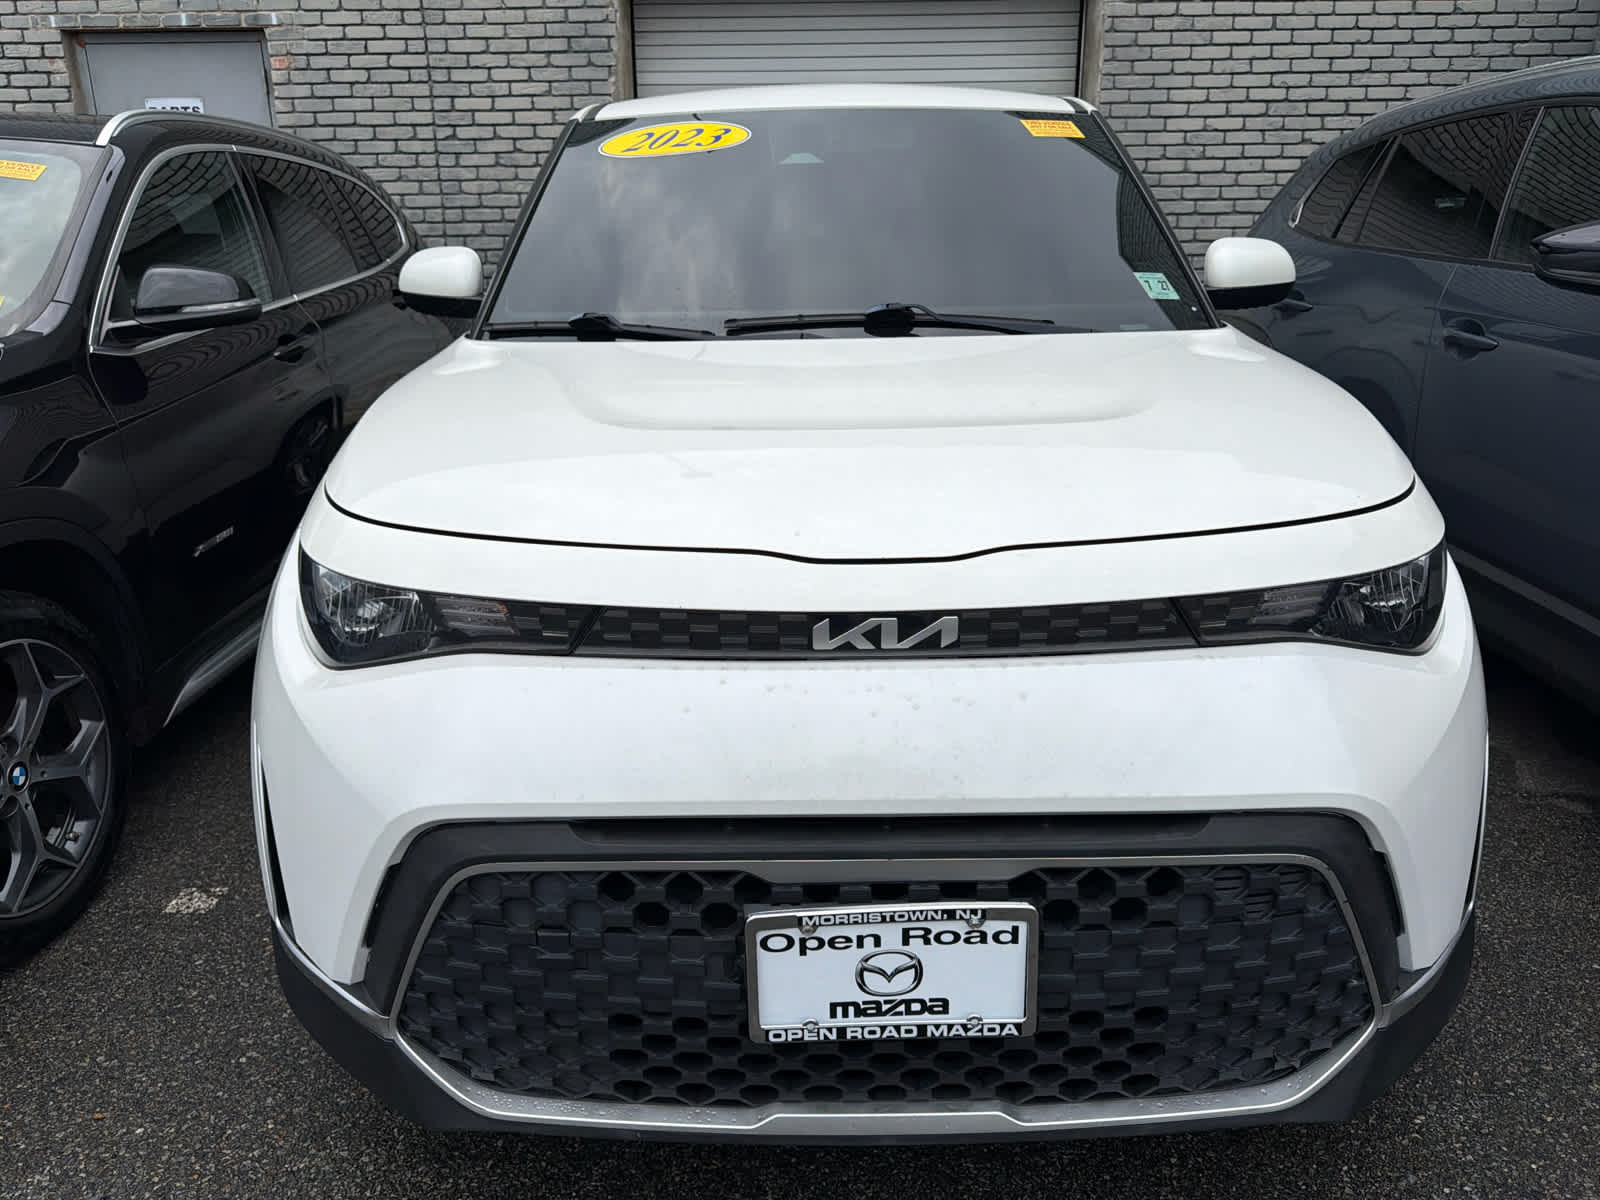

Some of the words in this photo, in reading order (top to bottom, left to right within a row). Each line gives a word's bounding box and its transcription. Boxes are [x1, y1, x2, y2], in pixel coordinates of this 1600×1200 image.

[621, 128, 732, 153] 2023
[812, 616, 959, 650] KIA
[802, 910, 948, 926] MORRISTOWN,
[955, 909, 982, 921] NJ
[759, 932, 882, 956] Open
[901, 925, 1020, 946] Road
[768, 1027, 838, 1043] OPEN
[846, 1025, 917, 1040] ROAD
[926, 1023, 1020, 1038] MAZDA
